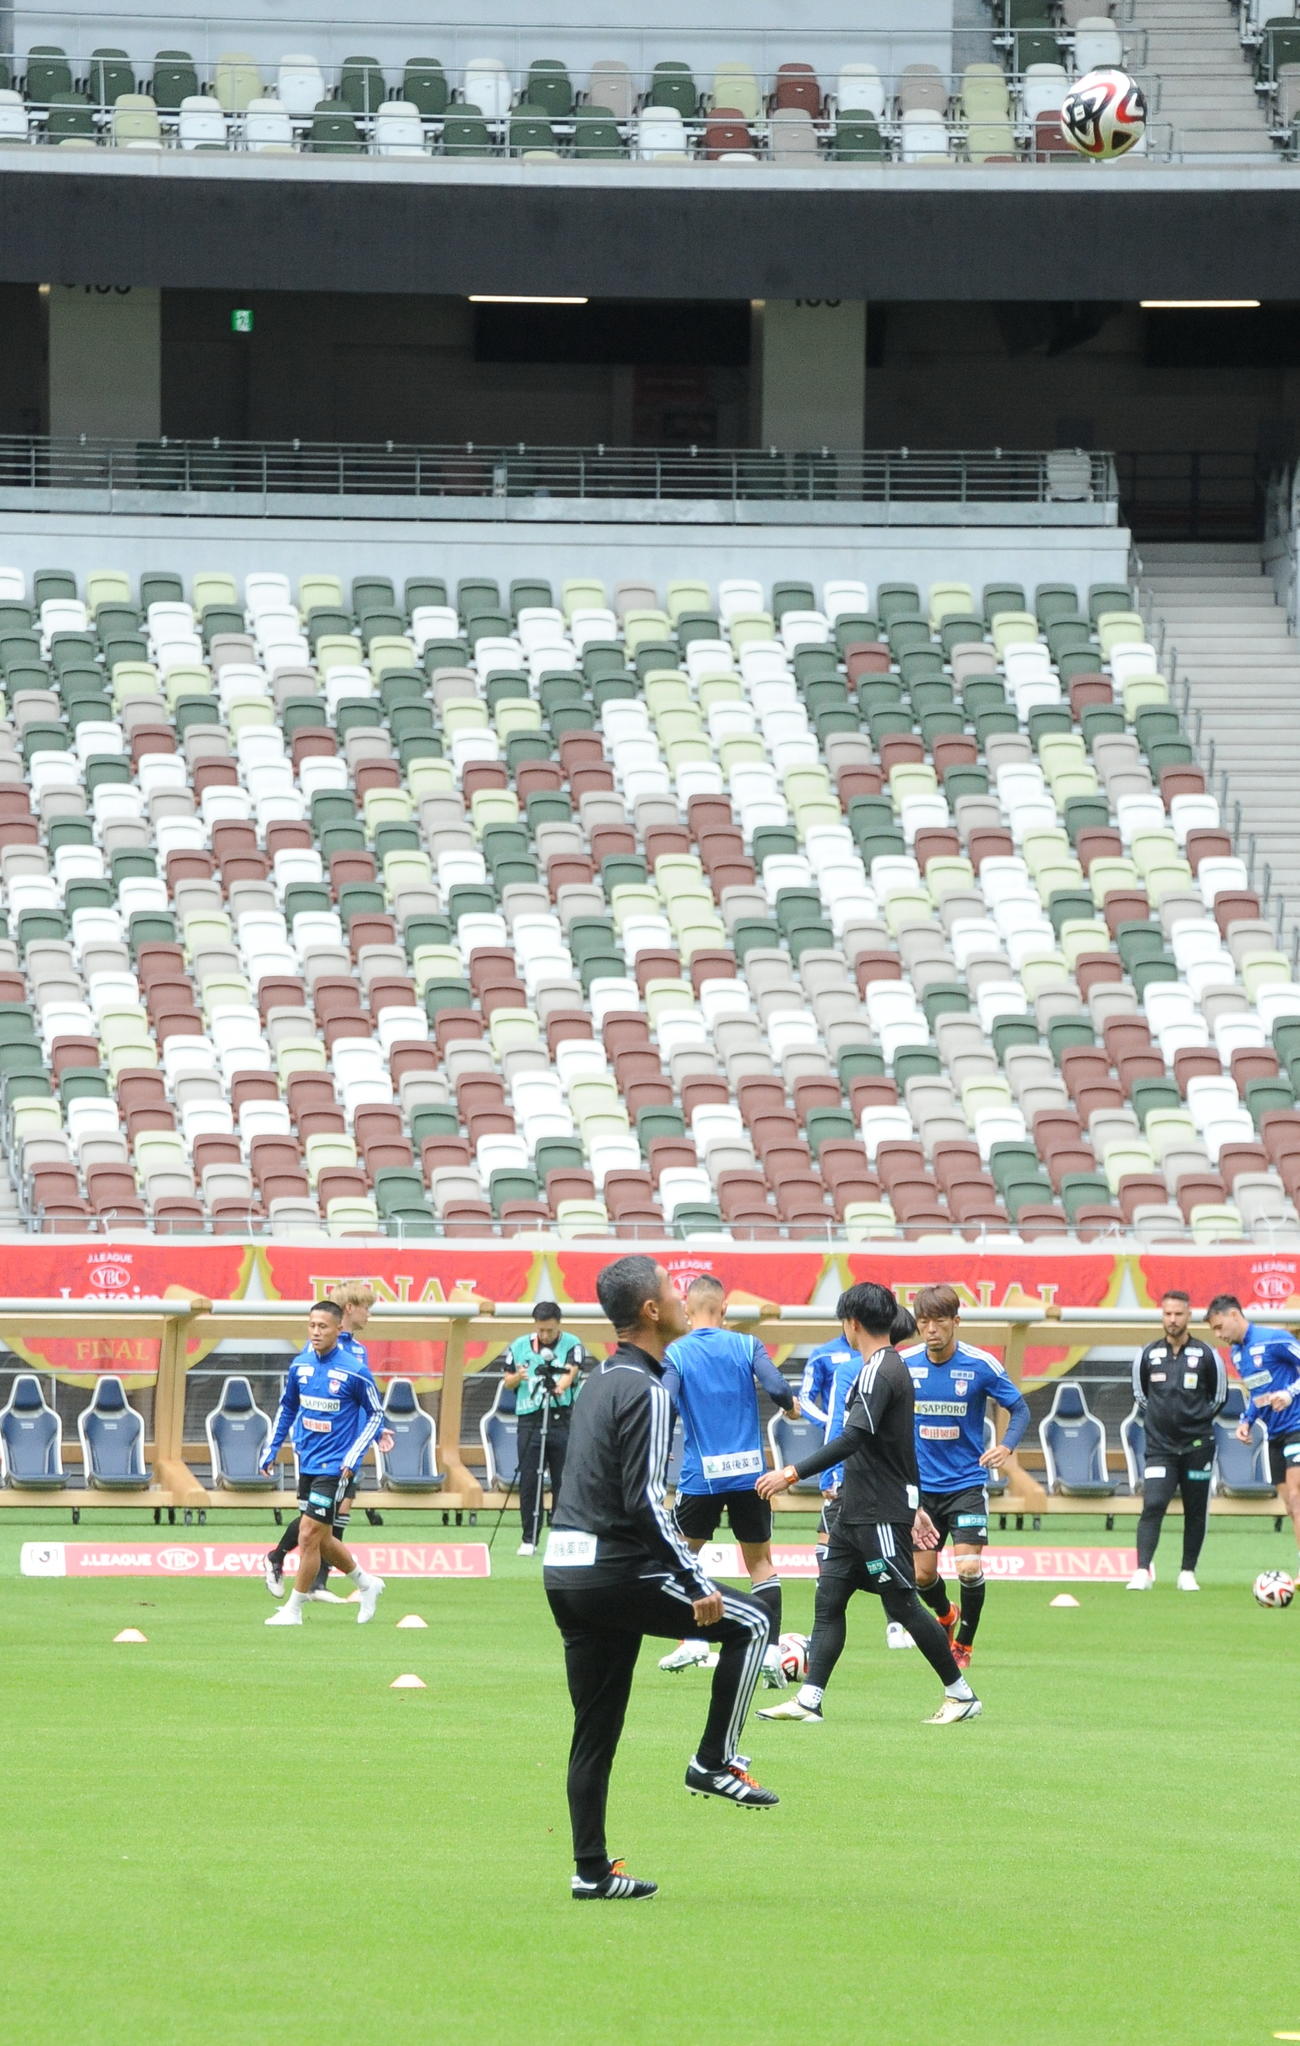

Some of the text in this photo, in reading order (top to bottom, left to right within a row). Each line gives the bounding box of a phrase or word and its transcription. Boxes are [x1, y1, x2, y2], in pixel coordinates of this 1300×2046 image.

[76, 1340, 150, 1361] FINAL
[921, 1403, 967, 1414] SAPPORO
[80, 1553, 152, 1567] J.LEAGUE
[203, 1547, 300, 1572] Levan
[368, 1548, 473, 1572] FINAL
[1033, 1551, 1138, 1575] FINAL
